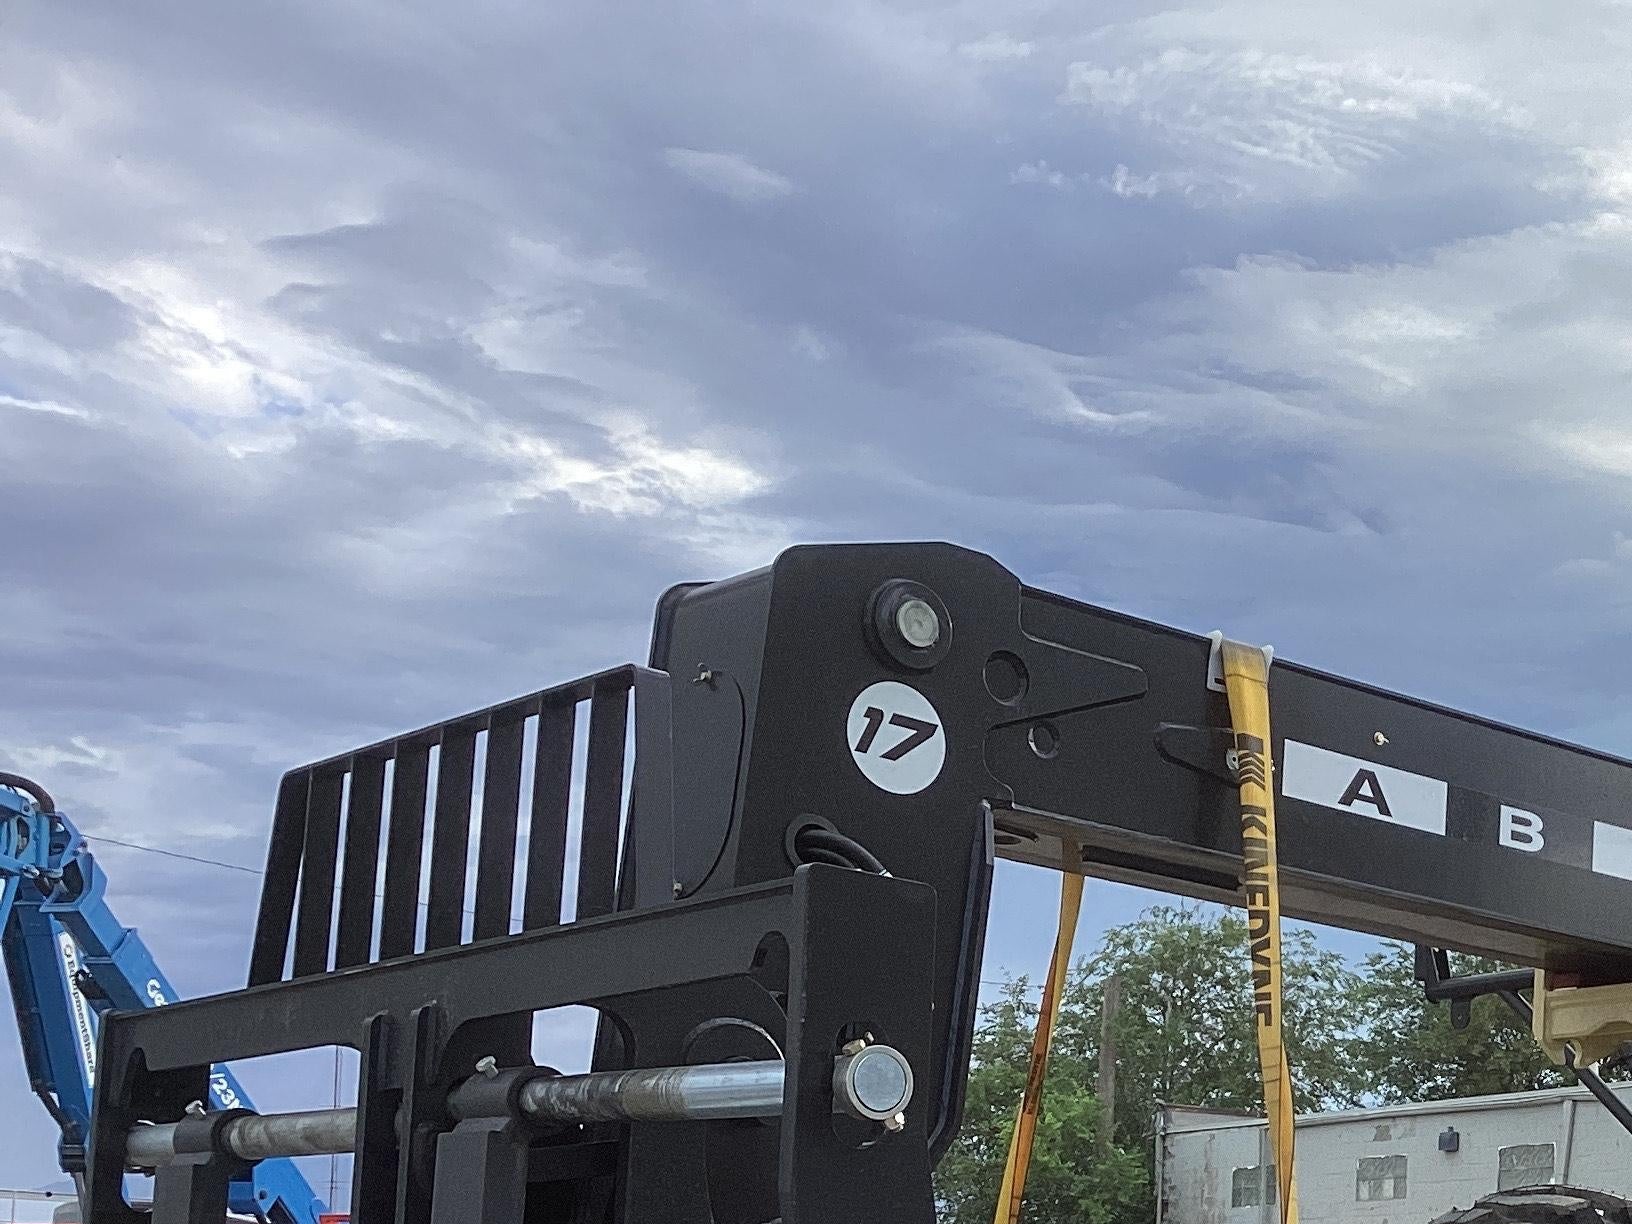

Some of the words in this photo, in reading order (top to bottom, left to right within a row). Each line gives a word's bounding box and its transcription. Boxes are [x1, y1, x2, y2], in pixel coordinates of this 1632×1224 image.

[854, 706, 939, 761] 17
[1338, 768, 1393, 819] A
[1498, 802, 1545, 853] B
